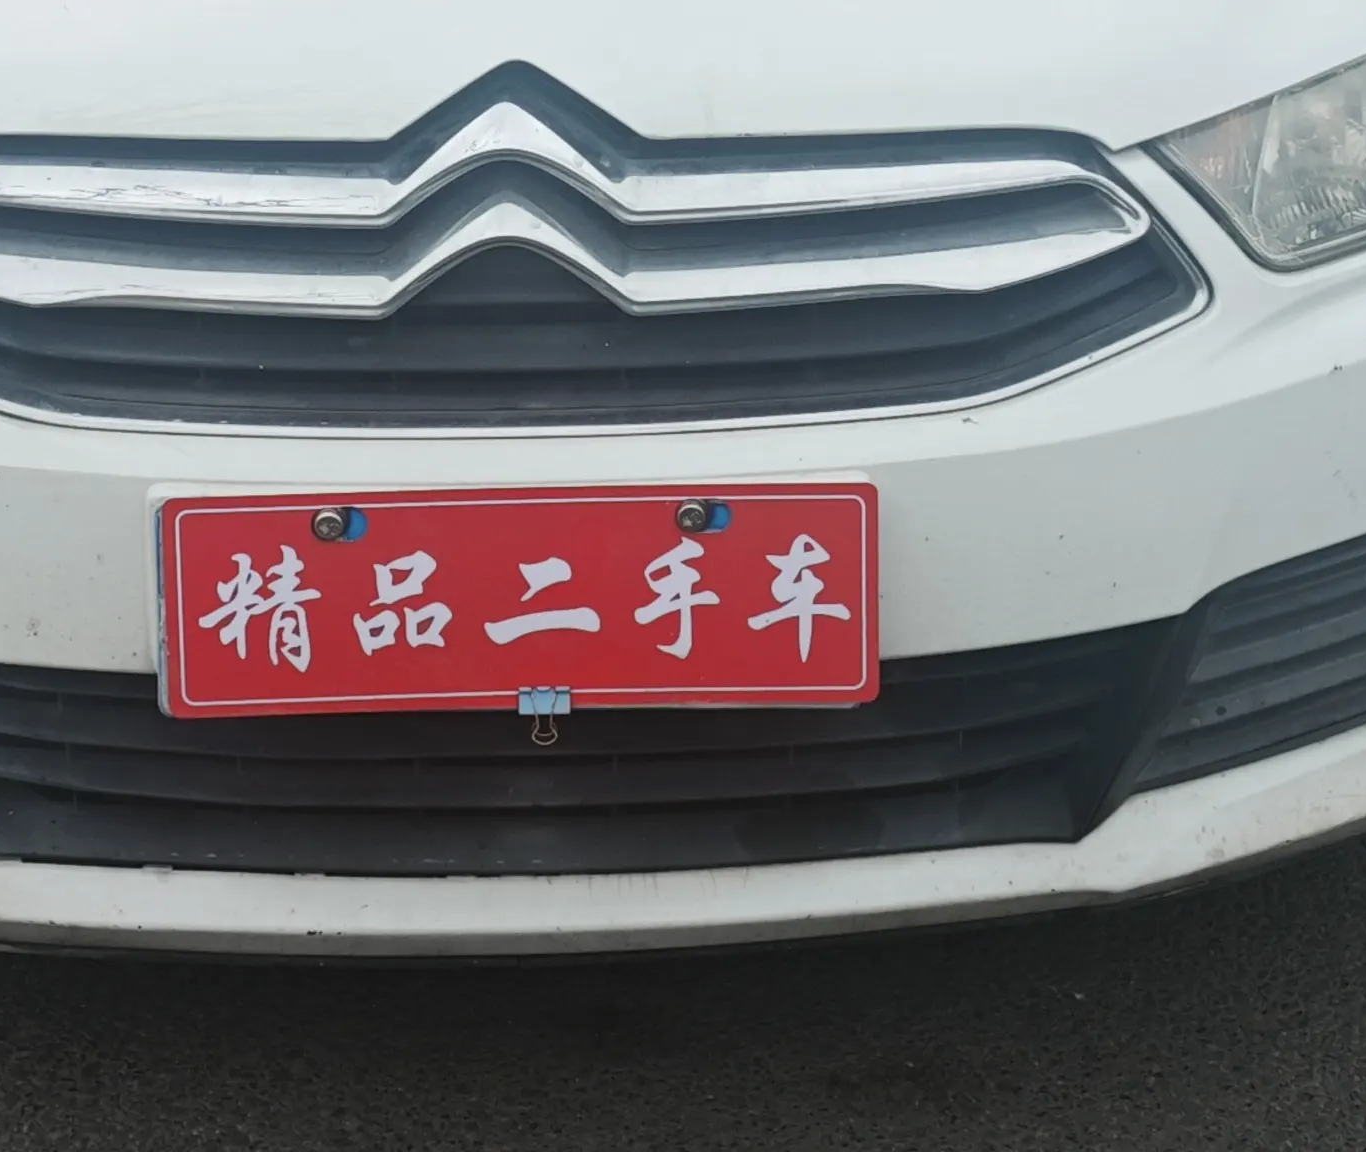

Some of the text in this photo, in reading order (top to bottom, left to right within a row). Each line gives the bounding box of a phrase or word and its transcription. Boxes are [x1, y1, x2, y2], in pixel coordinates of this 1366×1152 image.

[198, 533, 851, 672] 精品二手车
